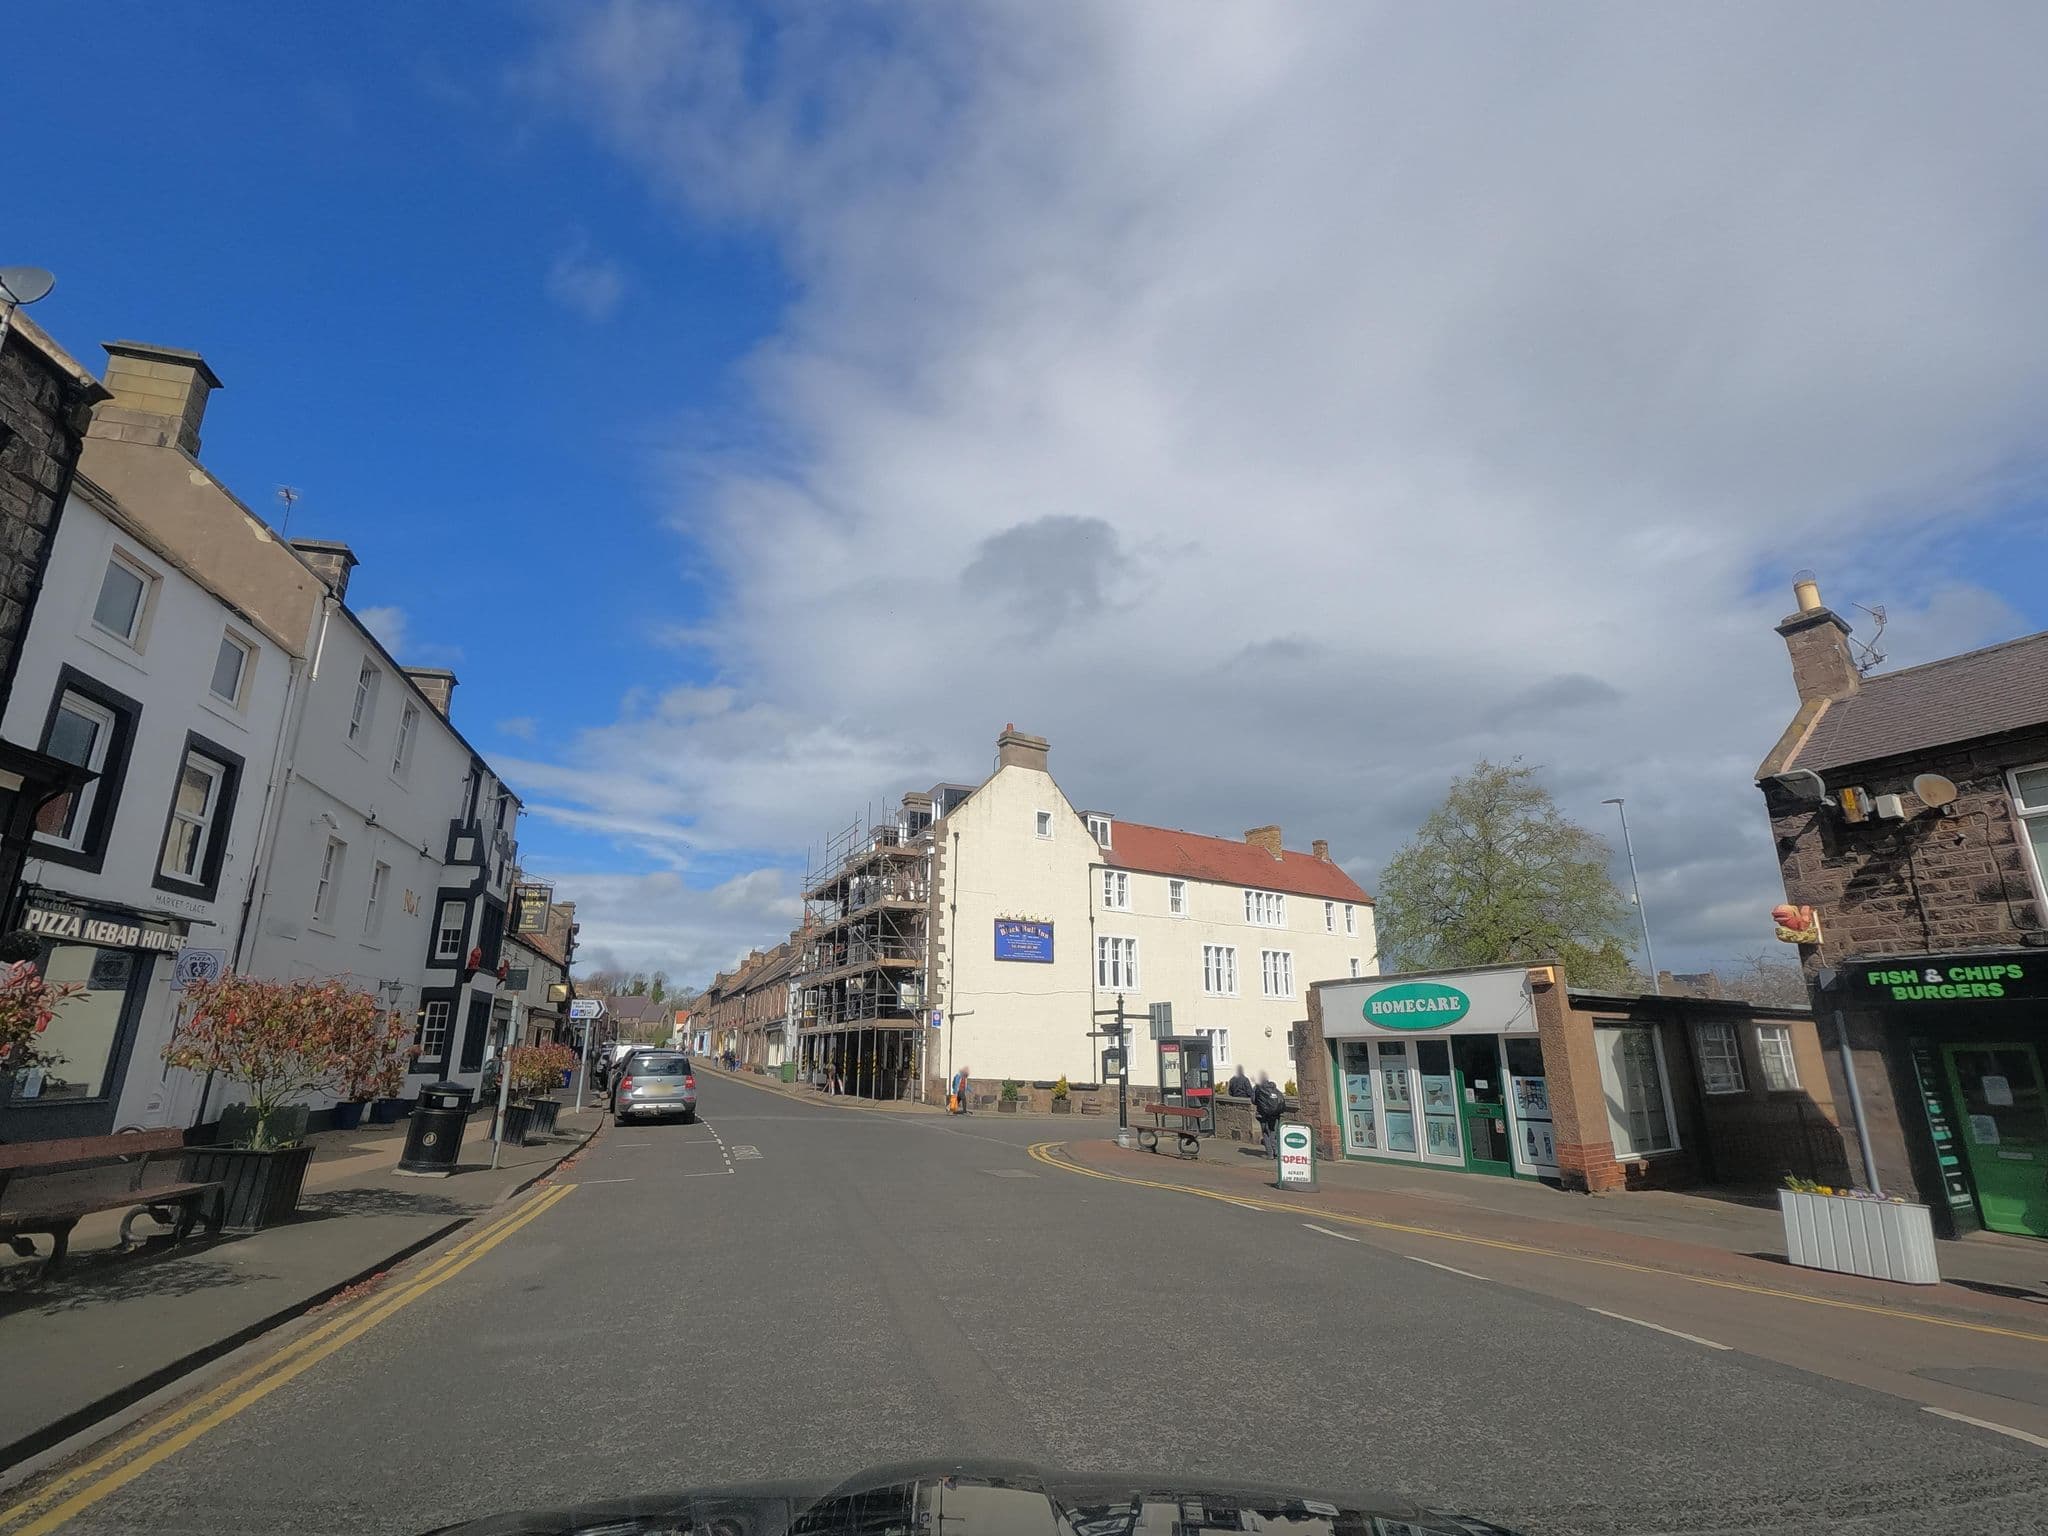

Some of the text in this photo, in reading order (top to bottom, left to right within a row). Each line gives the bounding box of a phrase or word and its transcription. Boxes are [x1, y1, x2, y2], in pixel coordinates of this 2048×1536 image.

[155, 894, 207, 914] MARKET PLACE
[25, 908, 188, 951] PIZZA KEBAB HOUSE
[1867, 964, 2024, 985] FISH & CHIPS
[1892, 982, 2004, 1000] BURGERS
[1371, 996, 1461, 1015] HOMECARE
[1283, 1155, 1308, 1165] OPEN
